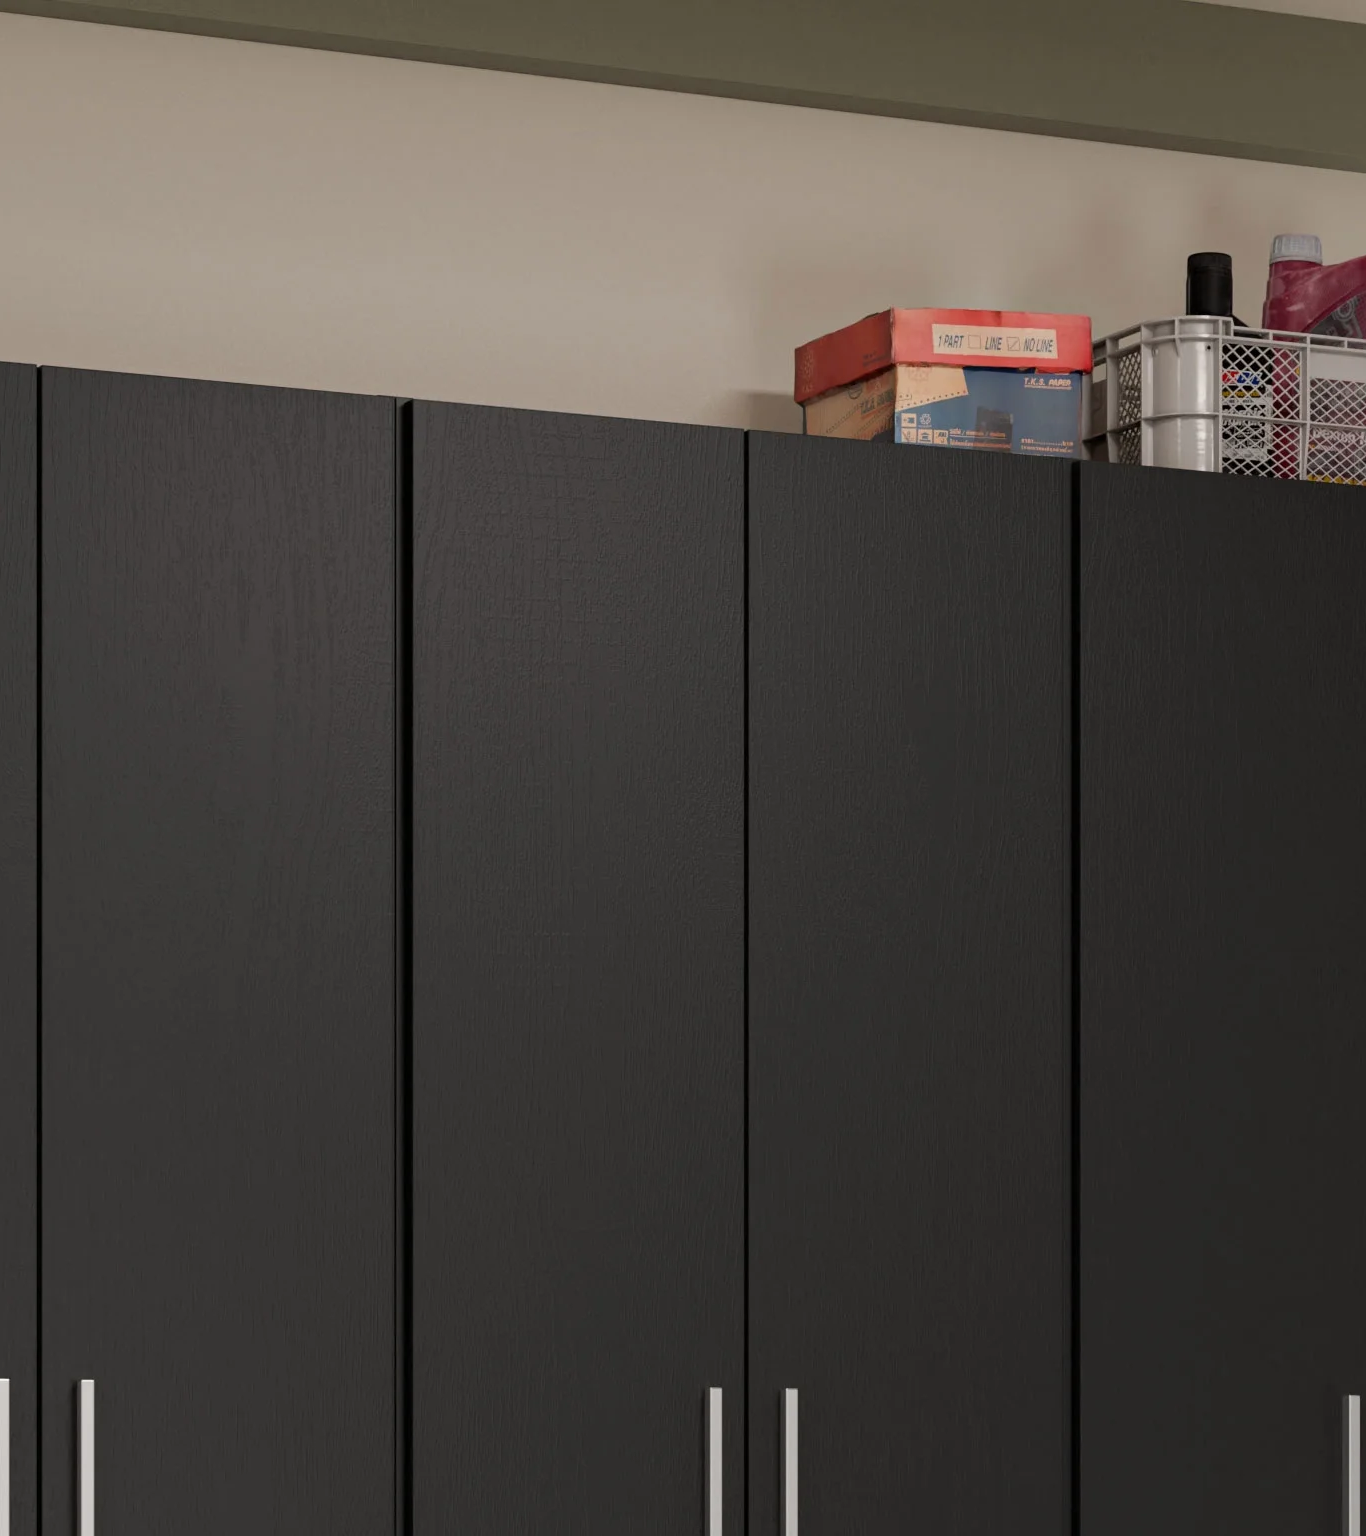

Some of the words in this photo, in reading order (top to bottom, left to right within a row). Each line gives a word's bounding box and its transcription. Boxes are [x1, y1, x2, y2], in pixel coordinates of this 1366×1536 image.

[943, 334, 965, 349] PART
[984, 336, 1003, 350] LINE
[1023, 338, 1036, 351] NO
[1036, 339, 1054, 353] LINE
